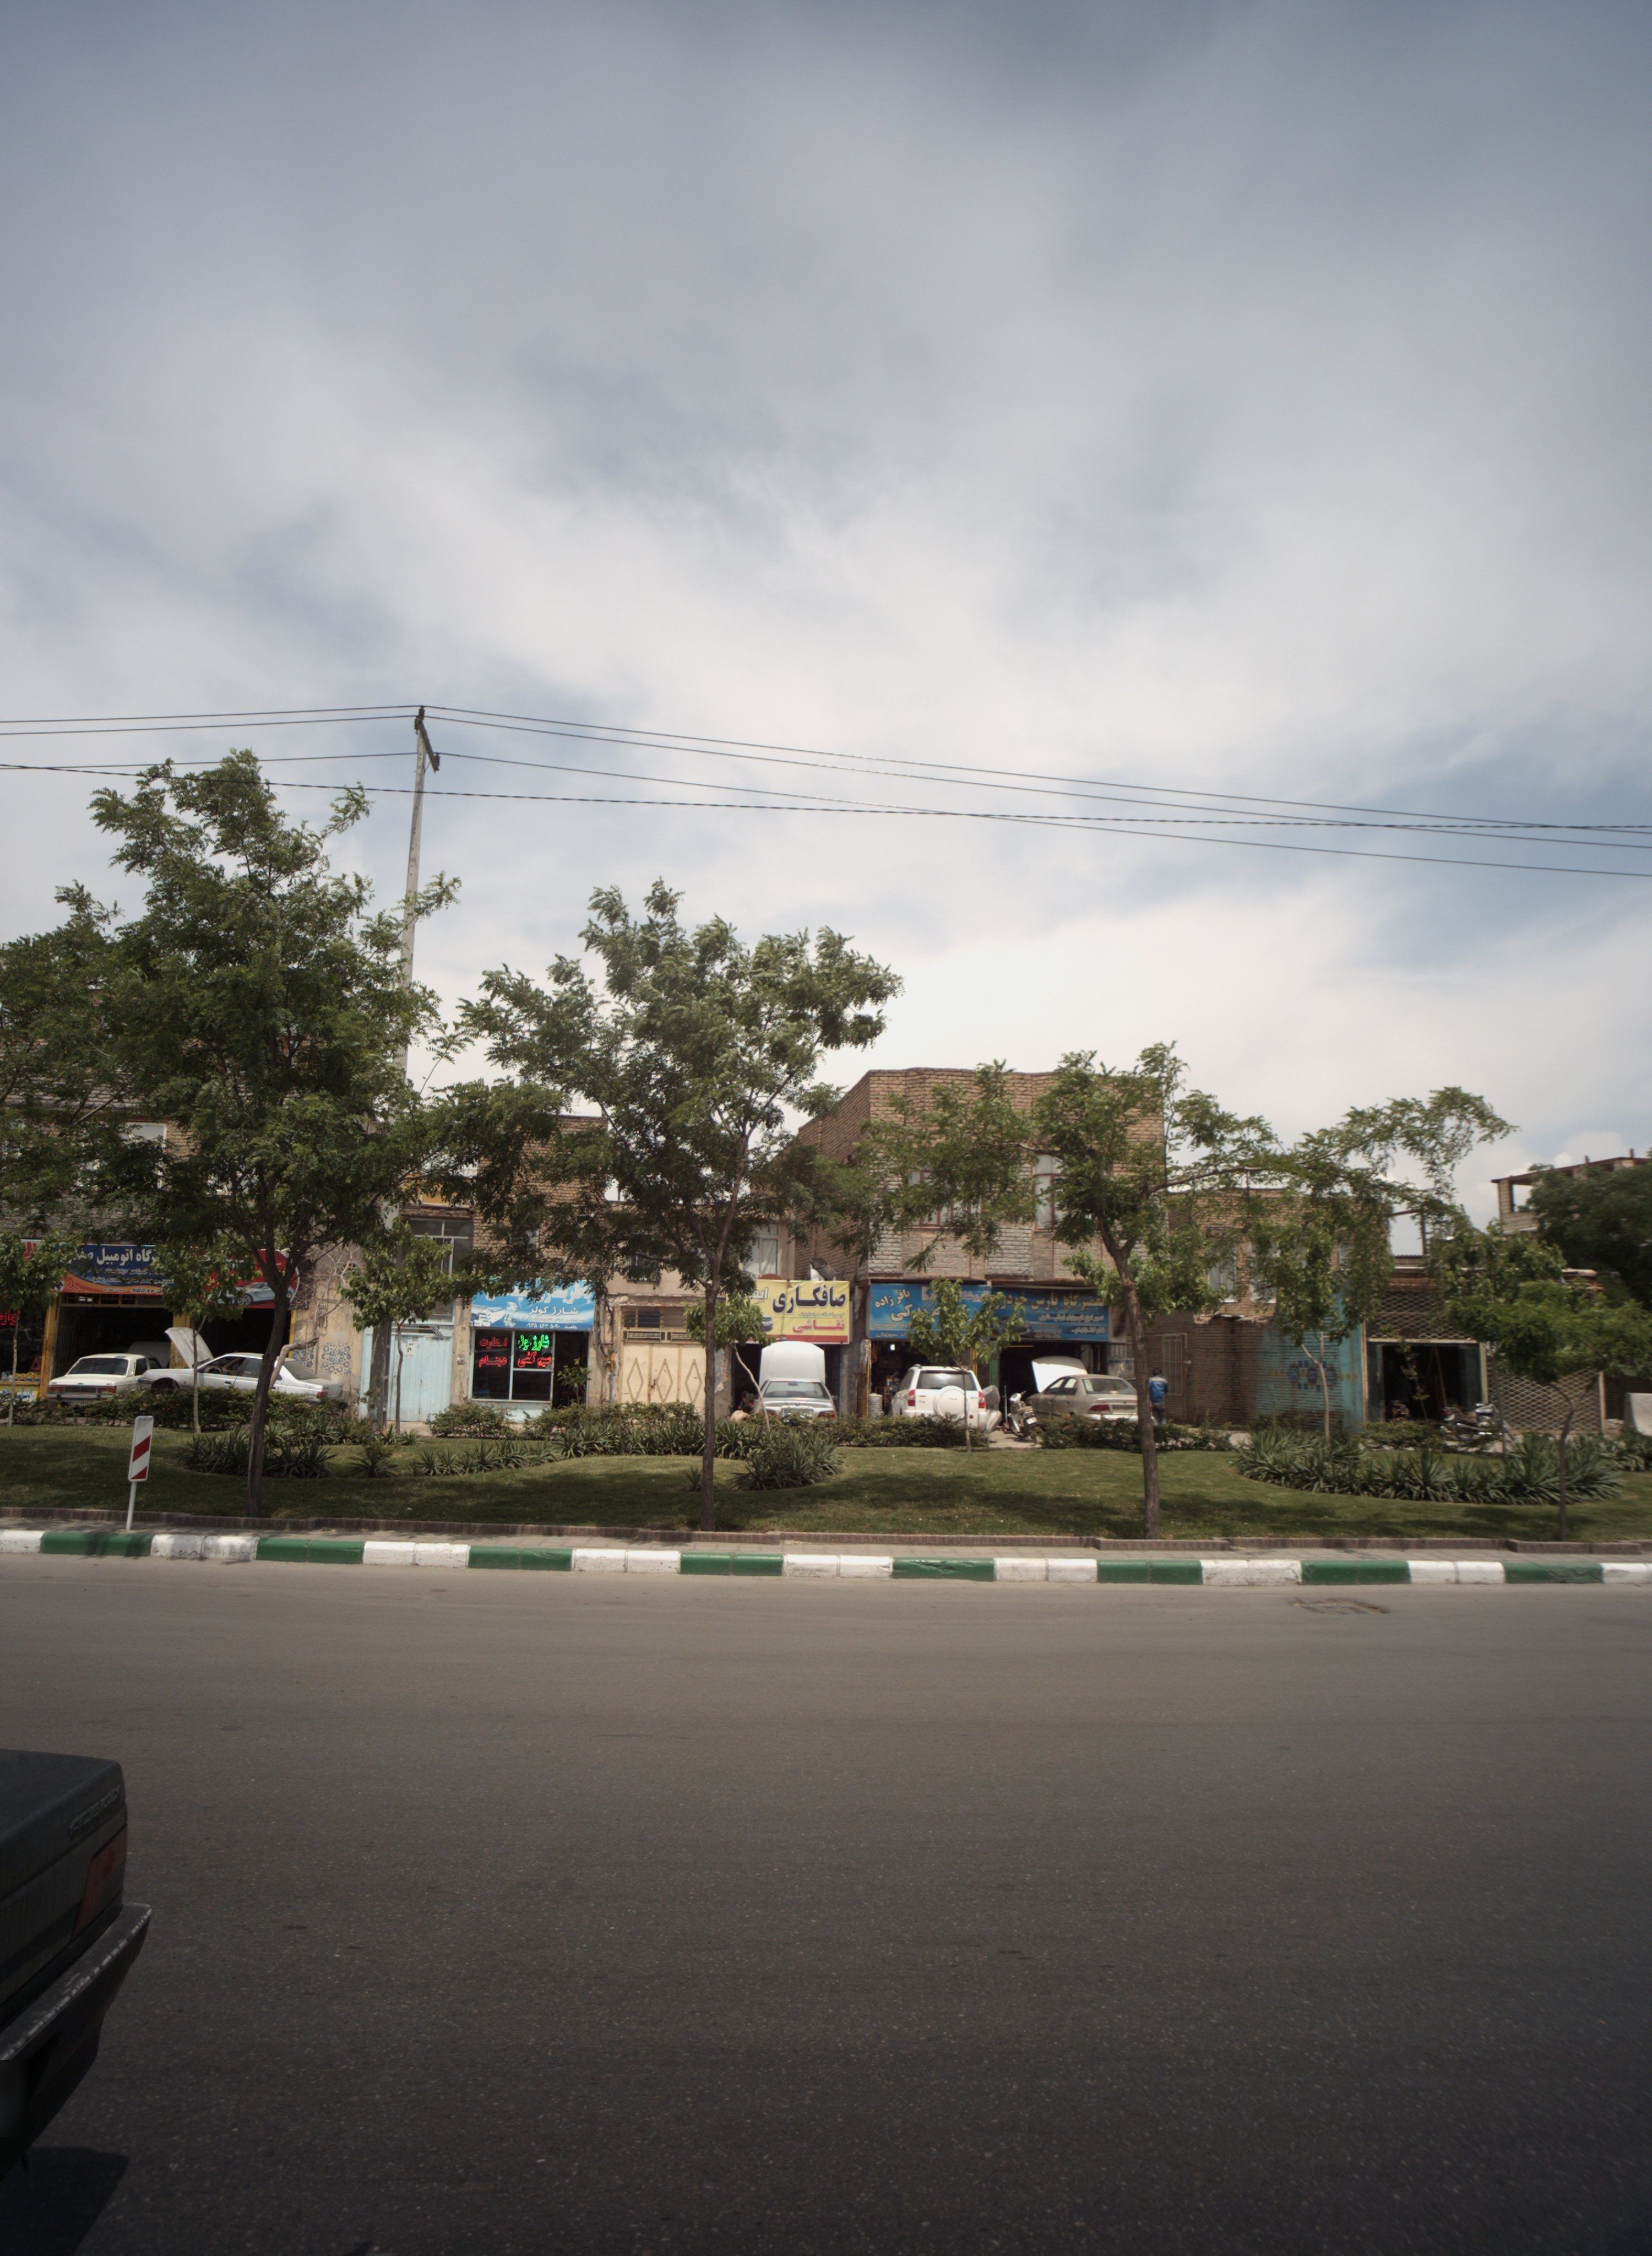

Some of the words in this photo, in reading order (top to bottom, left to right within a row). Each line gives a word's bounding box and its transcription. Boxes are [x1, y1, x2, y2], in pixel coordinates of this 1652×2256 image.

[96, 1248, 133, 1266] اتومبیل
[773, 1285, 846, 1314] صافکاری
[875, 1295, 894, 1308] زاده
[897, 1288, 911, 1305] باقر
[1031, 1292, 1058, 1311] پارس
[528, 1305, 549, 1316] کولر
[551, 1306, 578, 1316] شارژ
[792, 1319, 845, 1333] نقاشی
[479, 1336, 508, 1349] استارت
[479, 1355, 508, 1368] دینام
[517, 1351, 537, 1368] کشی
